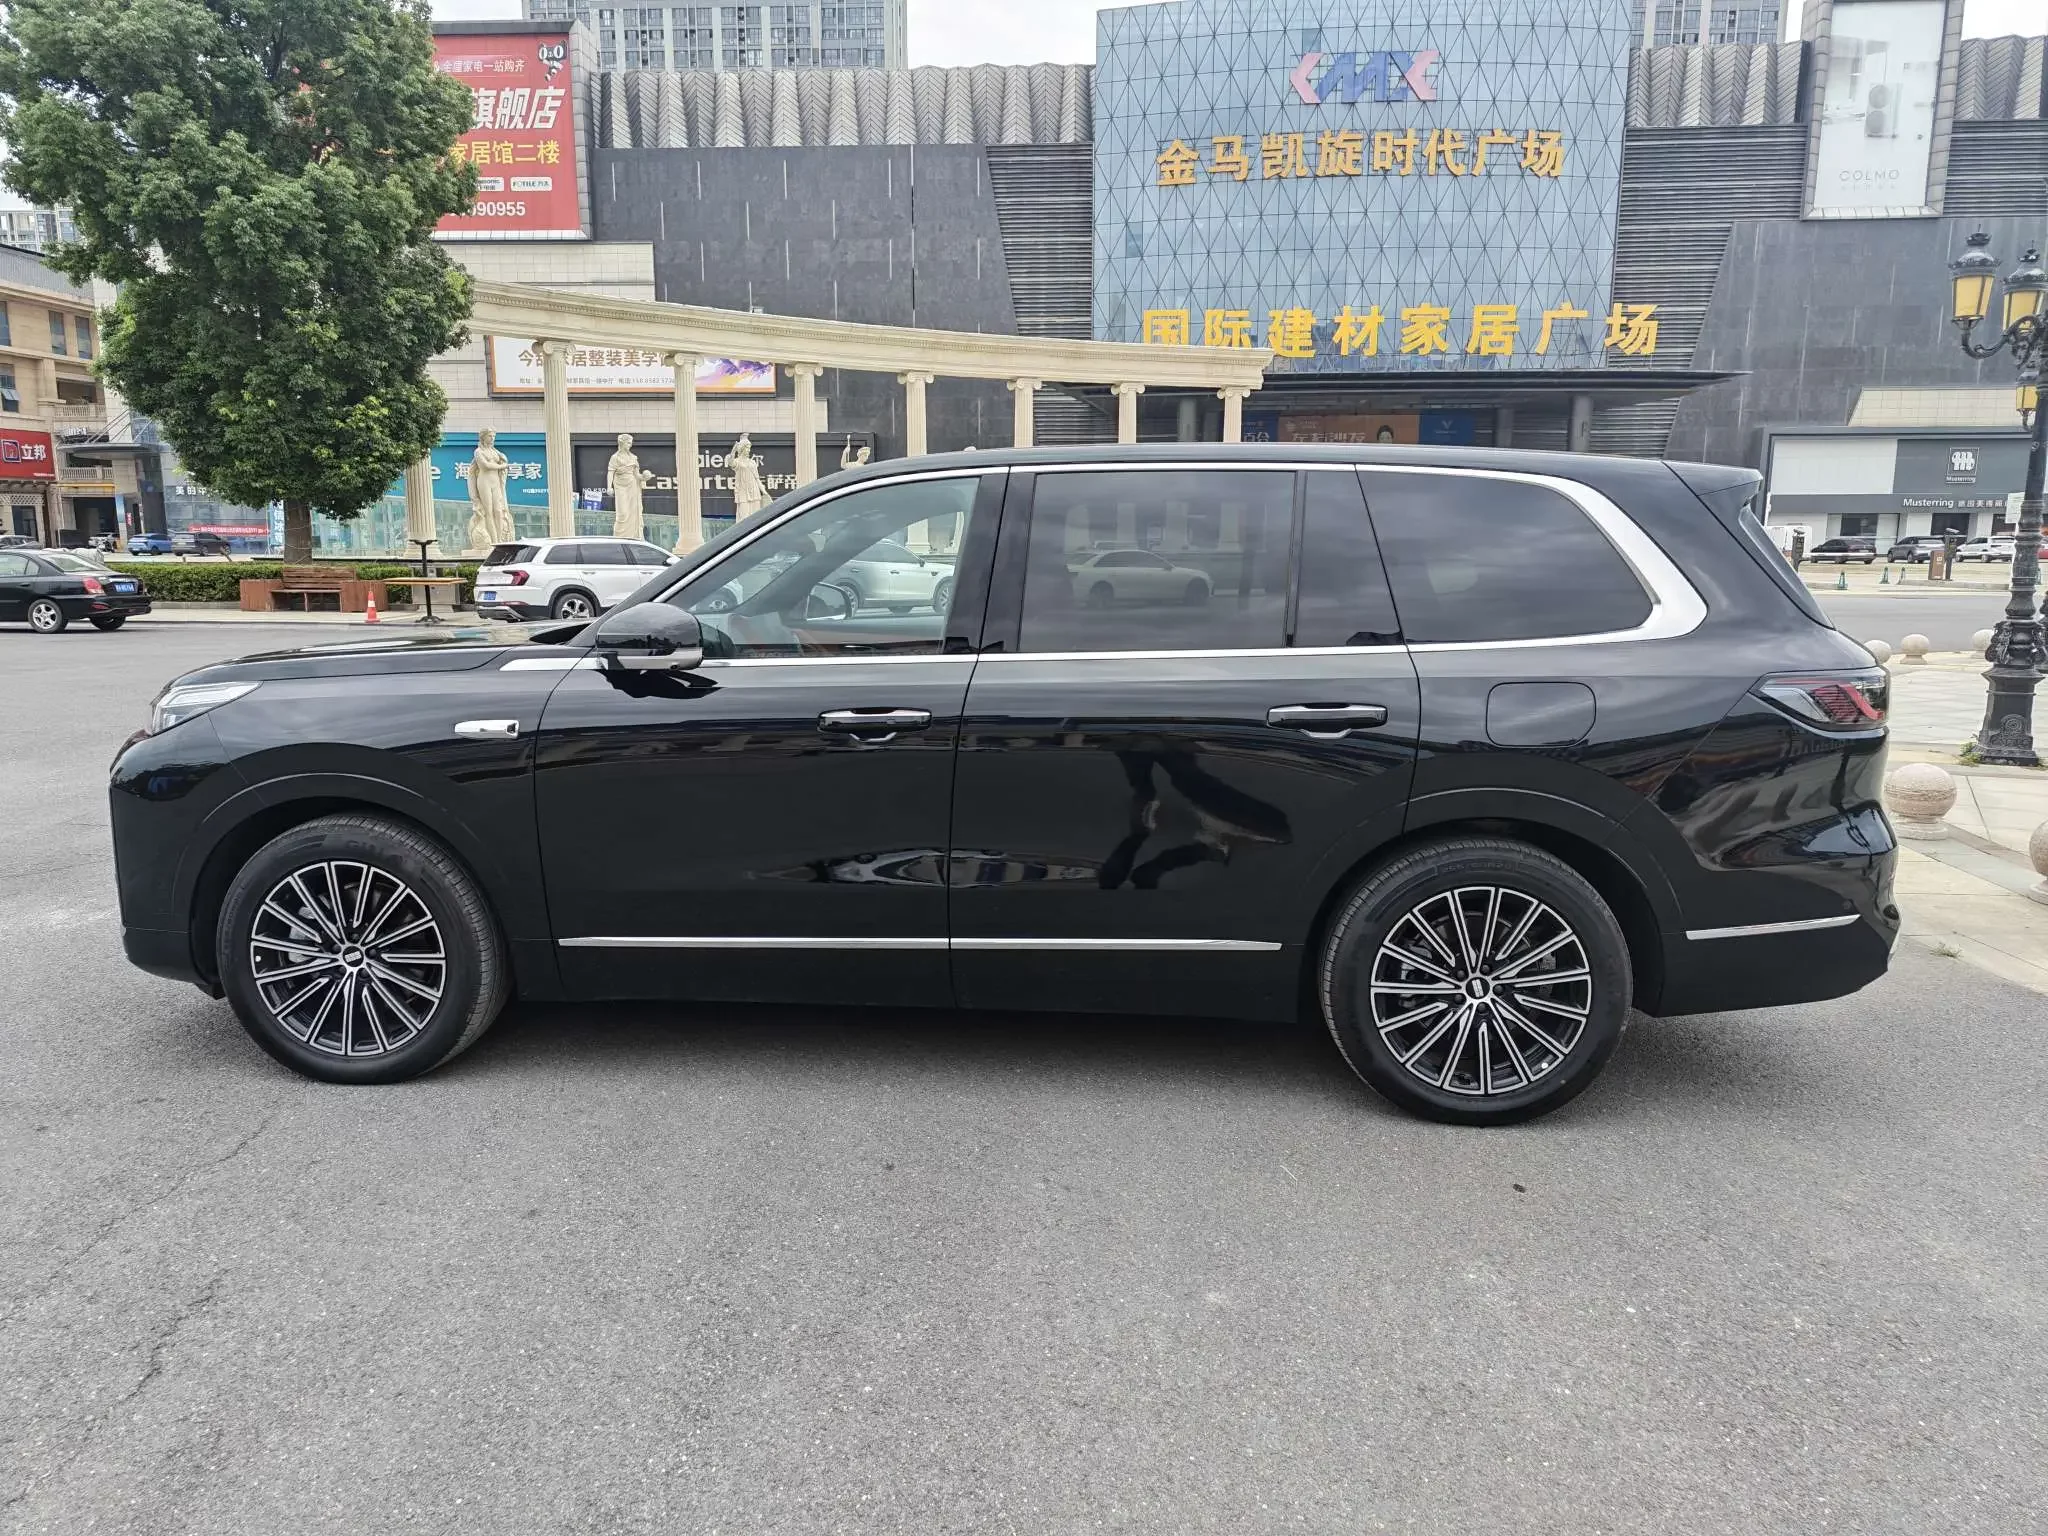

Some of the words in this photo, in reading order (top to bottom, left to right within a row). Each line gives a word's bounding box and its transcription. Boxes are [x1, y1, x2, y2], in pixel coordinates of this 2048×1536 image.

[1156, 128, 1565, 187] 金马凯旋时代广场
[1839, 169, 1900, 182] COLMO
[1142, 302, 1660, 359] 国际建材家居广场
[21, 444, 47, 461] 立邦
[1945, 476, 1977, 484] Musterring
[1903, 498, 1954, 509] Musterring
